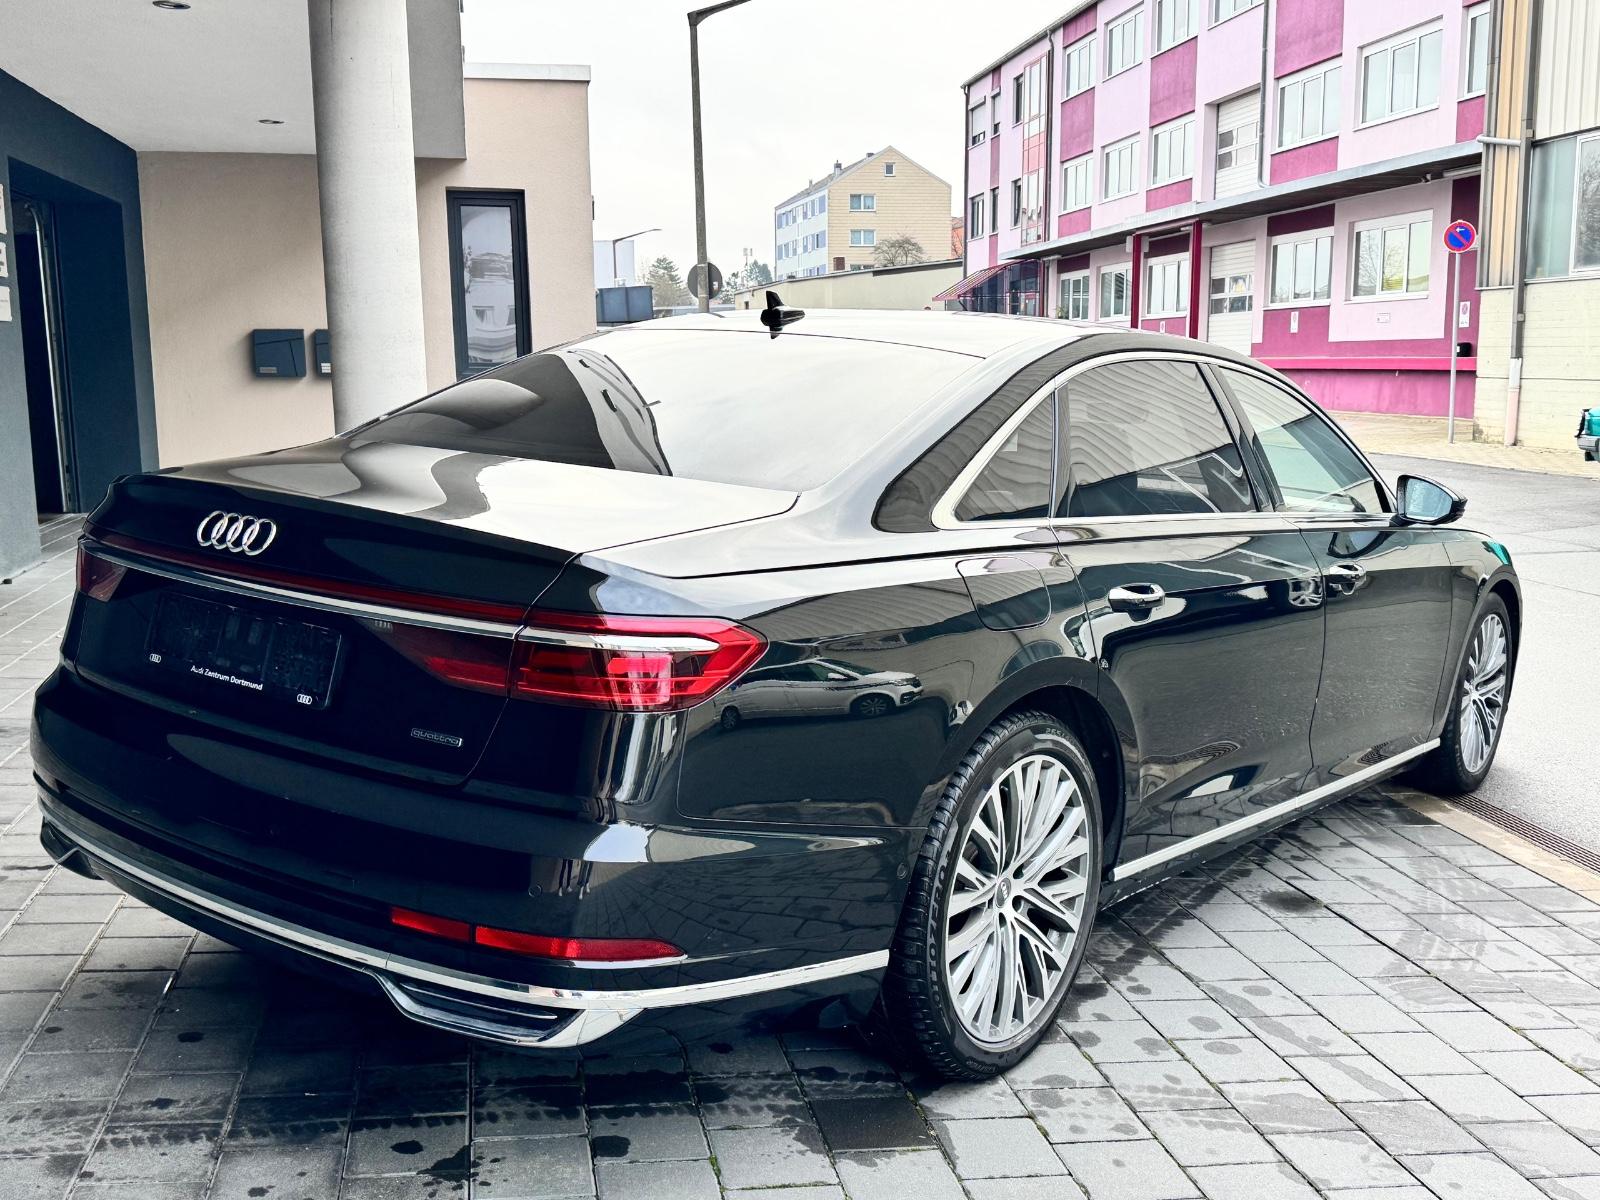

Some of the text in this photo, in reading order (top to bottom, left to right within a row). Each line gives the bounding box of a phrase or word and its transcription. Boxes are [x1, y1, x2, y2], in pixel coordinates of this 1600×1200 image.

[190, 664, 263, 690] Audi Zentrum Dortmund
[413, 729, 459, 746] quattro
